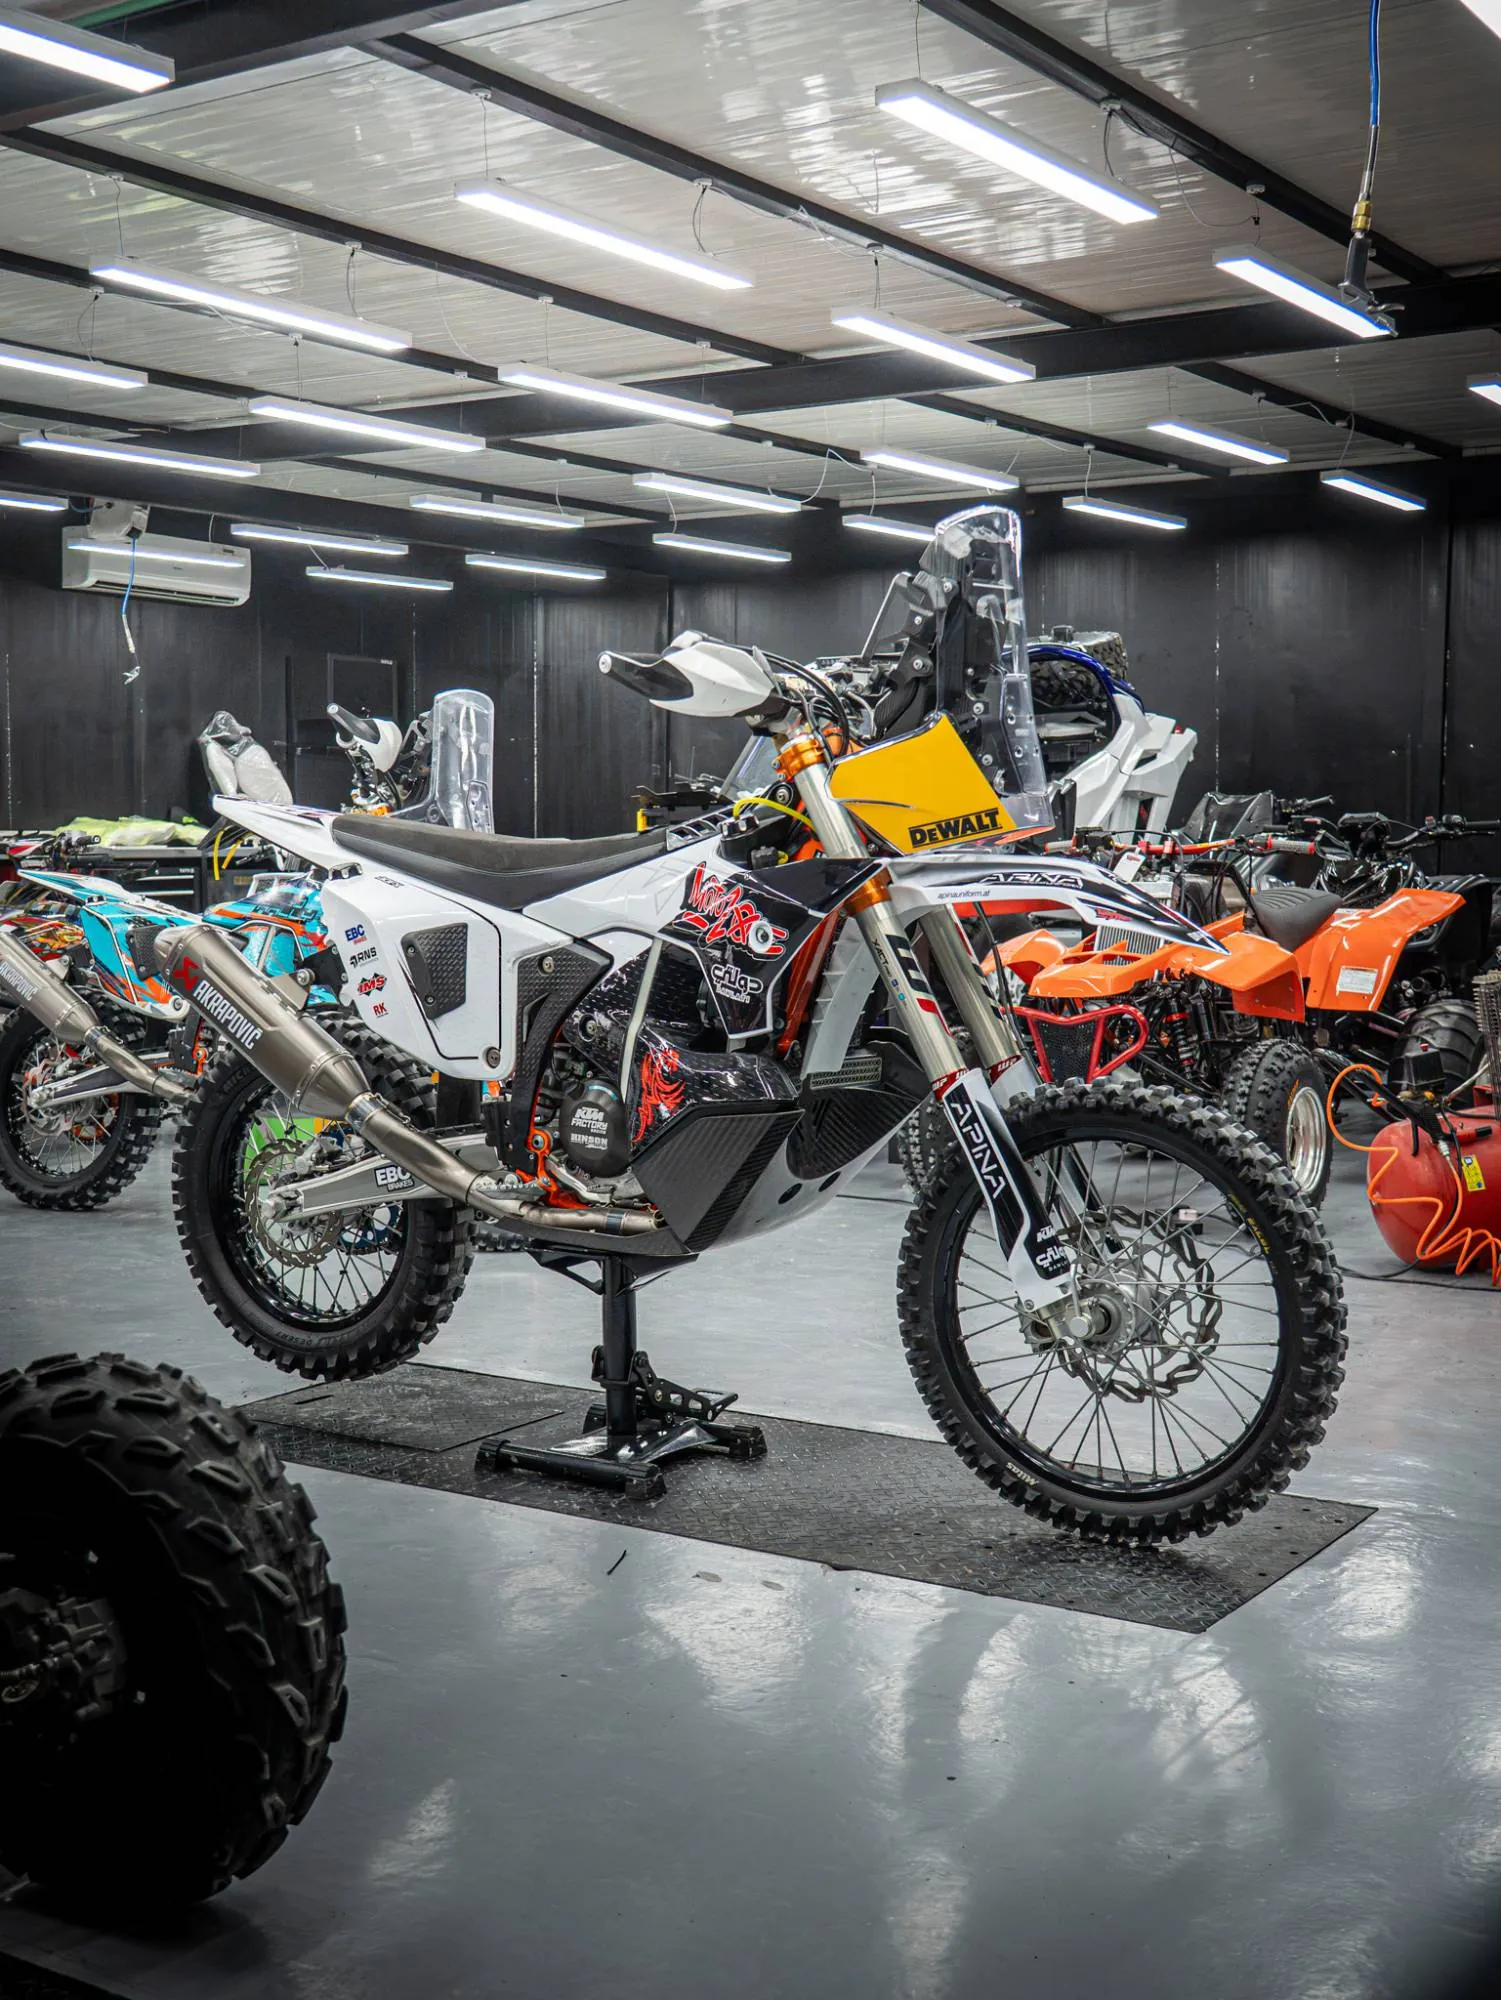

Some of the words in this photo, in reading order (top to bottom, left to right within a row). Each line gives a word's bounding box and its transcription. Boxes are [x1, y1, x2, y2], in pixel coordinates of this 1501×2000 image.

[345, 924, 365, 942] EBC
[358, 975, 385, 994] IMS
[373, 1002, 388, 1016] RK
[575, 1106, 605, 1122] KTM
[570, 1117, 609, 1131] FACTORY
[950, 1101, 1007, 1199] APINA
[375, 1166, 411, 1186] EBC
